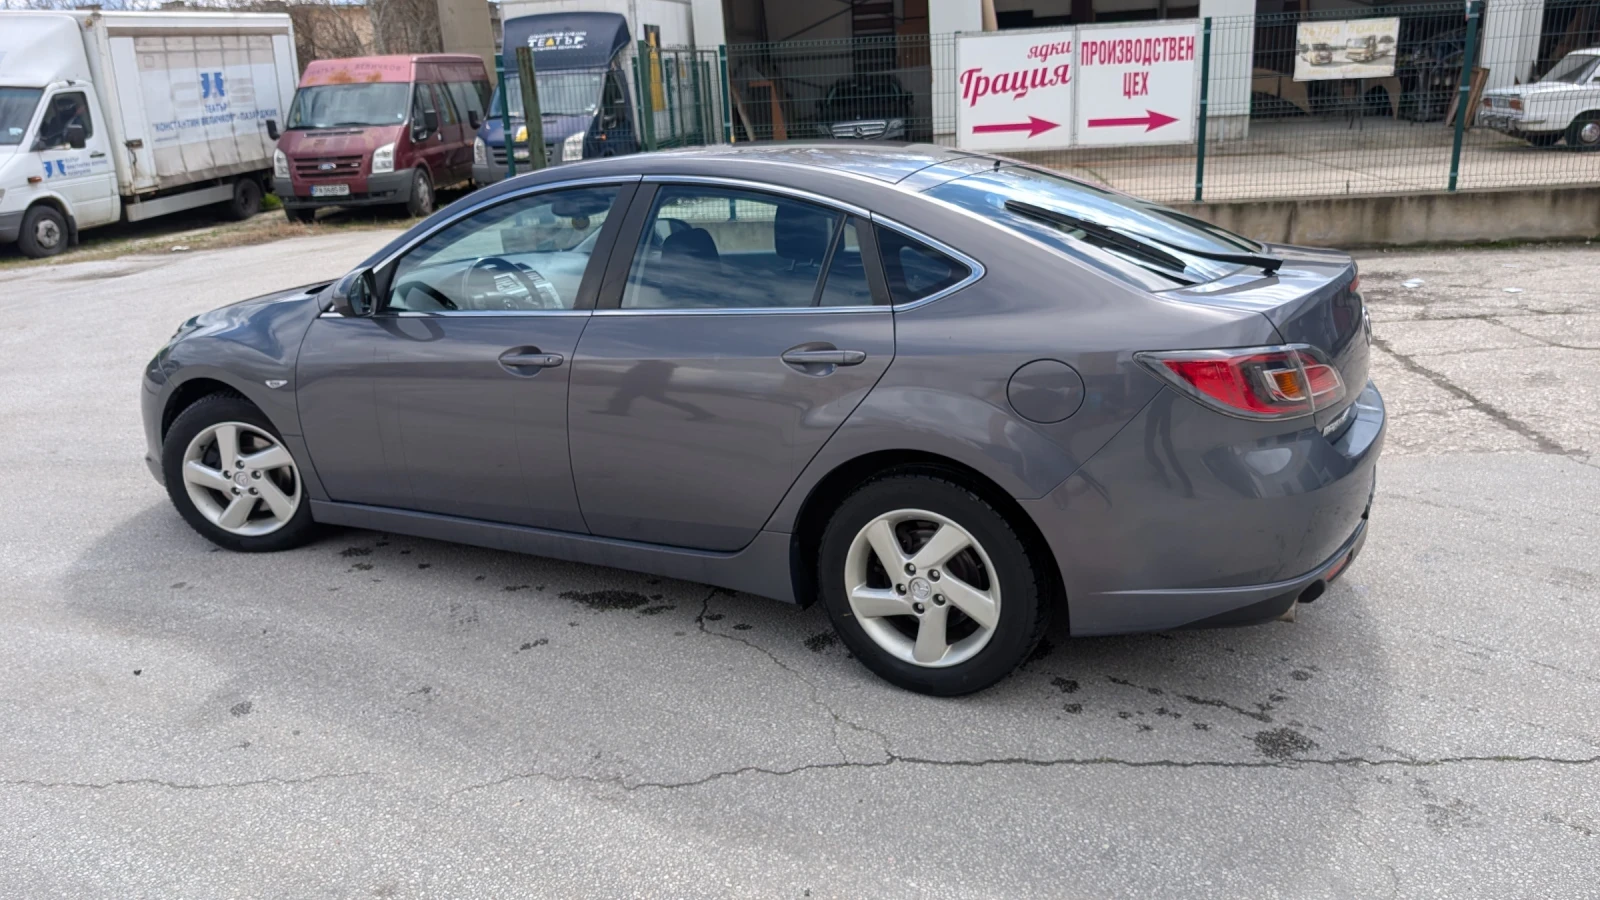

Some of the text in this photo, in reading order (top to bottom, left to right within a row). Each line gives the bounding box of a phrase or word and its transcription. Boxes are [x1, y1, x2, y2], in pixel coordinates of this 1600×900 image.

[1027, 41, 1072, 62] ядки
[1081, 36, 1195, 66] ПРОИЗВОДСТВЕН
[959, 63, 1072, 107] Грация
[1123, 72, 1149, 99] ЦЕХ
